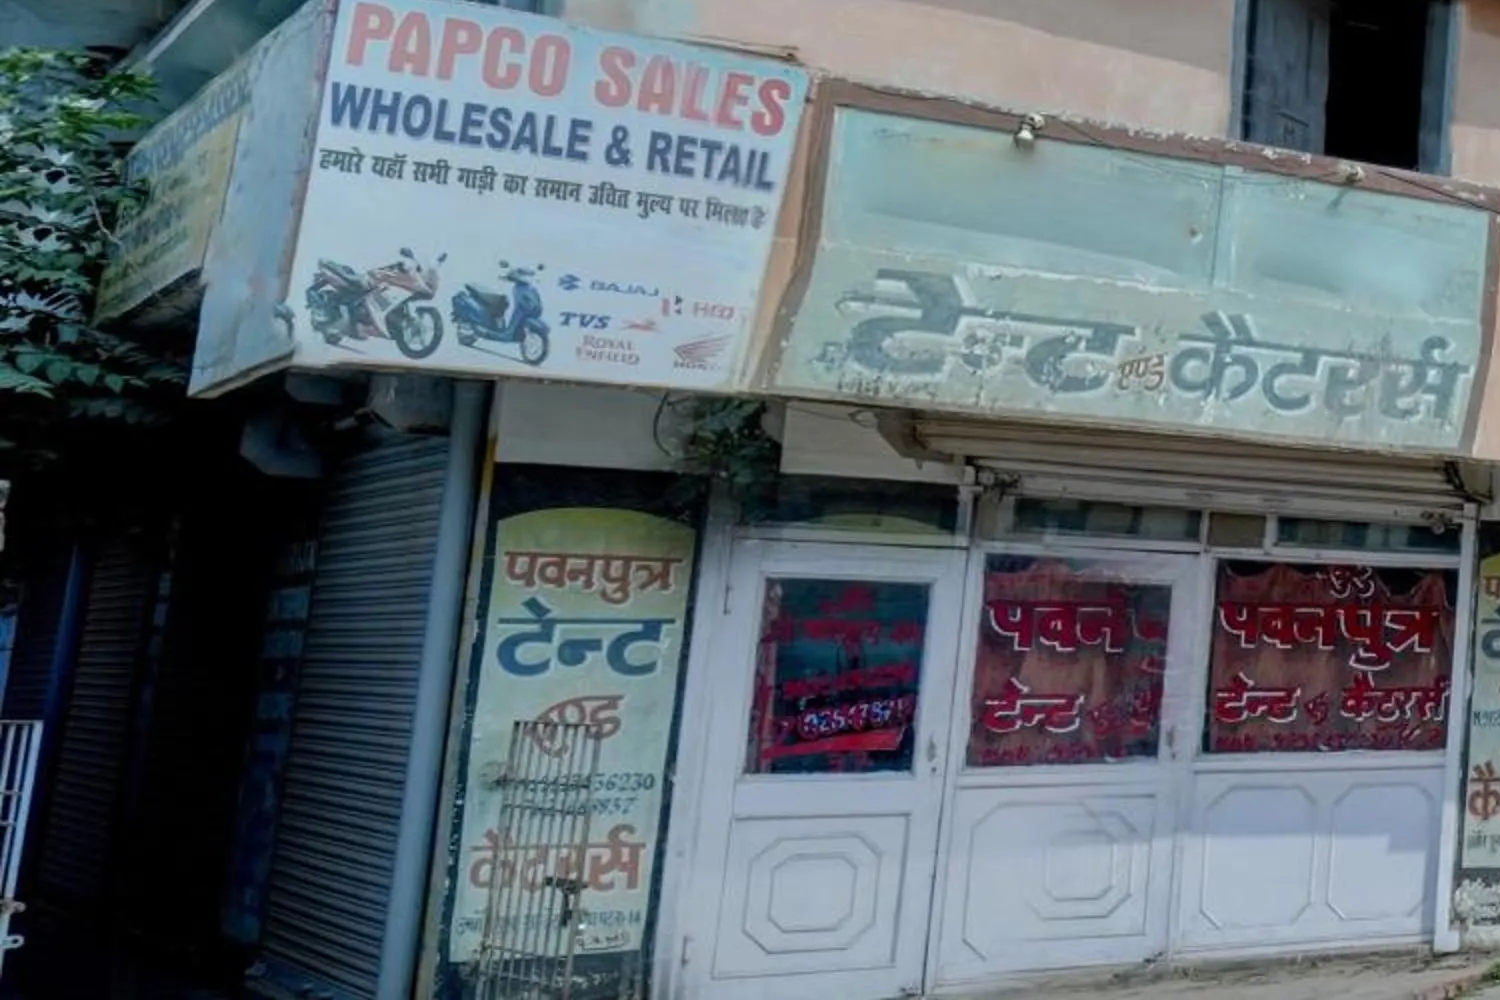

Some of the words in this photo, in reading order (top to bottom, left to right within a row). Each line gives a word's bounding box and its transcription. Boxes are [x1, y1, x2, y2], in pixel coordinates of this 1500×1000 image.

[345, 1, 573, 98] PAPCO
[594, 46, 792, 137] SALES
[328, 81, 594, 161] WHOLESALE
[604, 125, 632, 167] &
[646, 131, 777, 192] RETAIL
[319, 147, 366, 175] हमारे
[503, 173, 529, 195] का
[534, 178, 583, 203] समान
[588, 182, 632, 209] उचित
[679, 198, 701, 218] पर
[559, 311, 612, 330] TVS
[504, 551, 684, 605] पवनपुत्र
[496, 597, 676, 677] टेन्ट
[1217, 600, 1440, 672] पवनपुत्र
